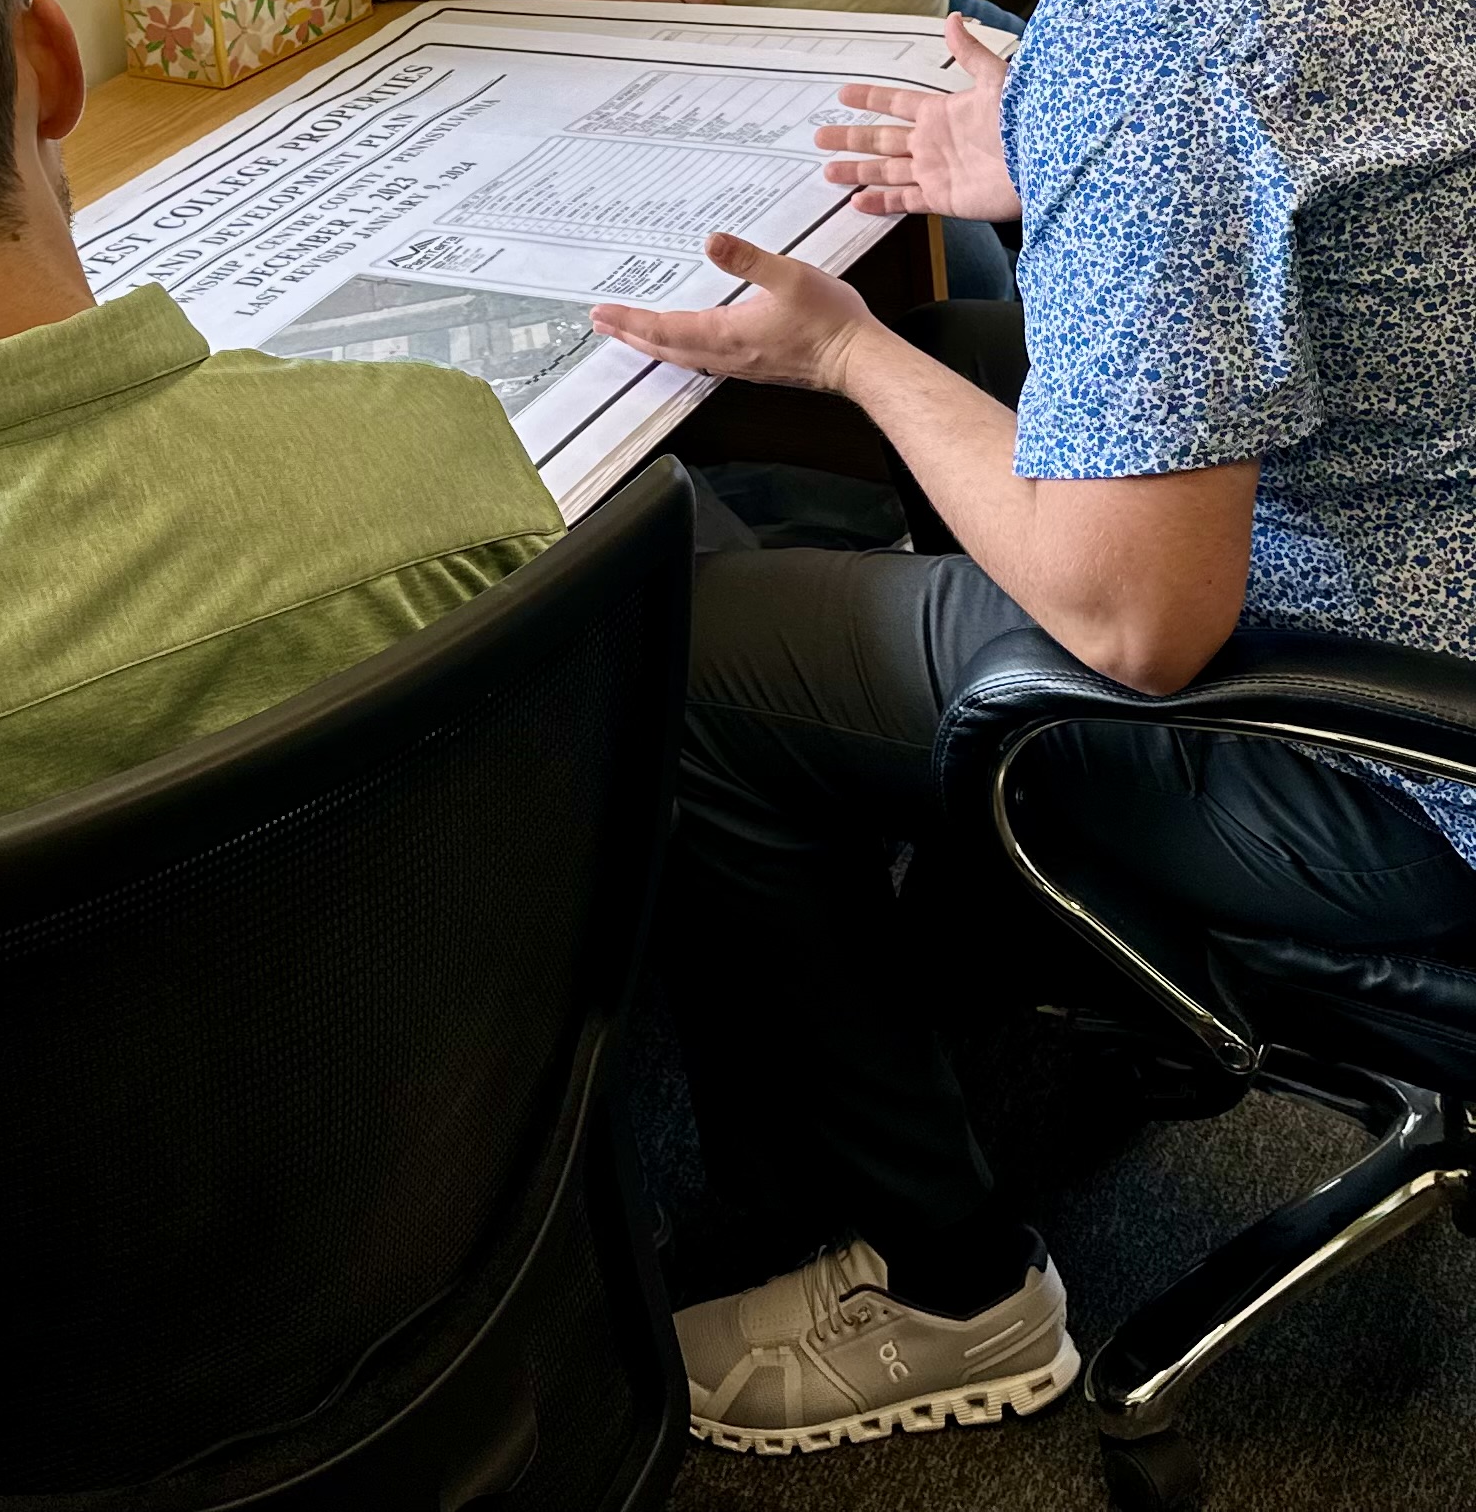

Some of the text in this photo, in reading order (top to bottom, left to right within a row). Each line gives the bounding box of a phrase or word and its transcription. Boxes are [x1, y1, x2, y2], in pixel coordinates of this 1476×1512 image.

[153, 156, 288, 229] COLLEGE
[276, 64, 433, 152] PROPERTIES
[199, 151, 364, 246] DEVELOPMENT
[355, 113, 420, 149] PLAN
[255, 212, 325, 250] CENTRE
[319, 172, 386, 211] COUNTY
[391, 98, 502, 164] PENNSYLVANIA
[234, 219, 359, 288] DECEMBER
[369, 177, 419, 201] 2023
[234, 287, 288, 316] LAST
[280, 241, 357, 284] REVISED
[352, 193, 429, 239] JANUARY
[439, 161, 477, 181] 2024
